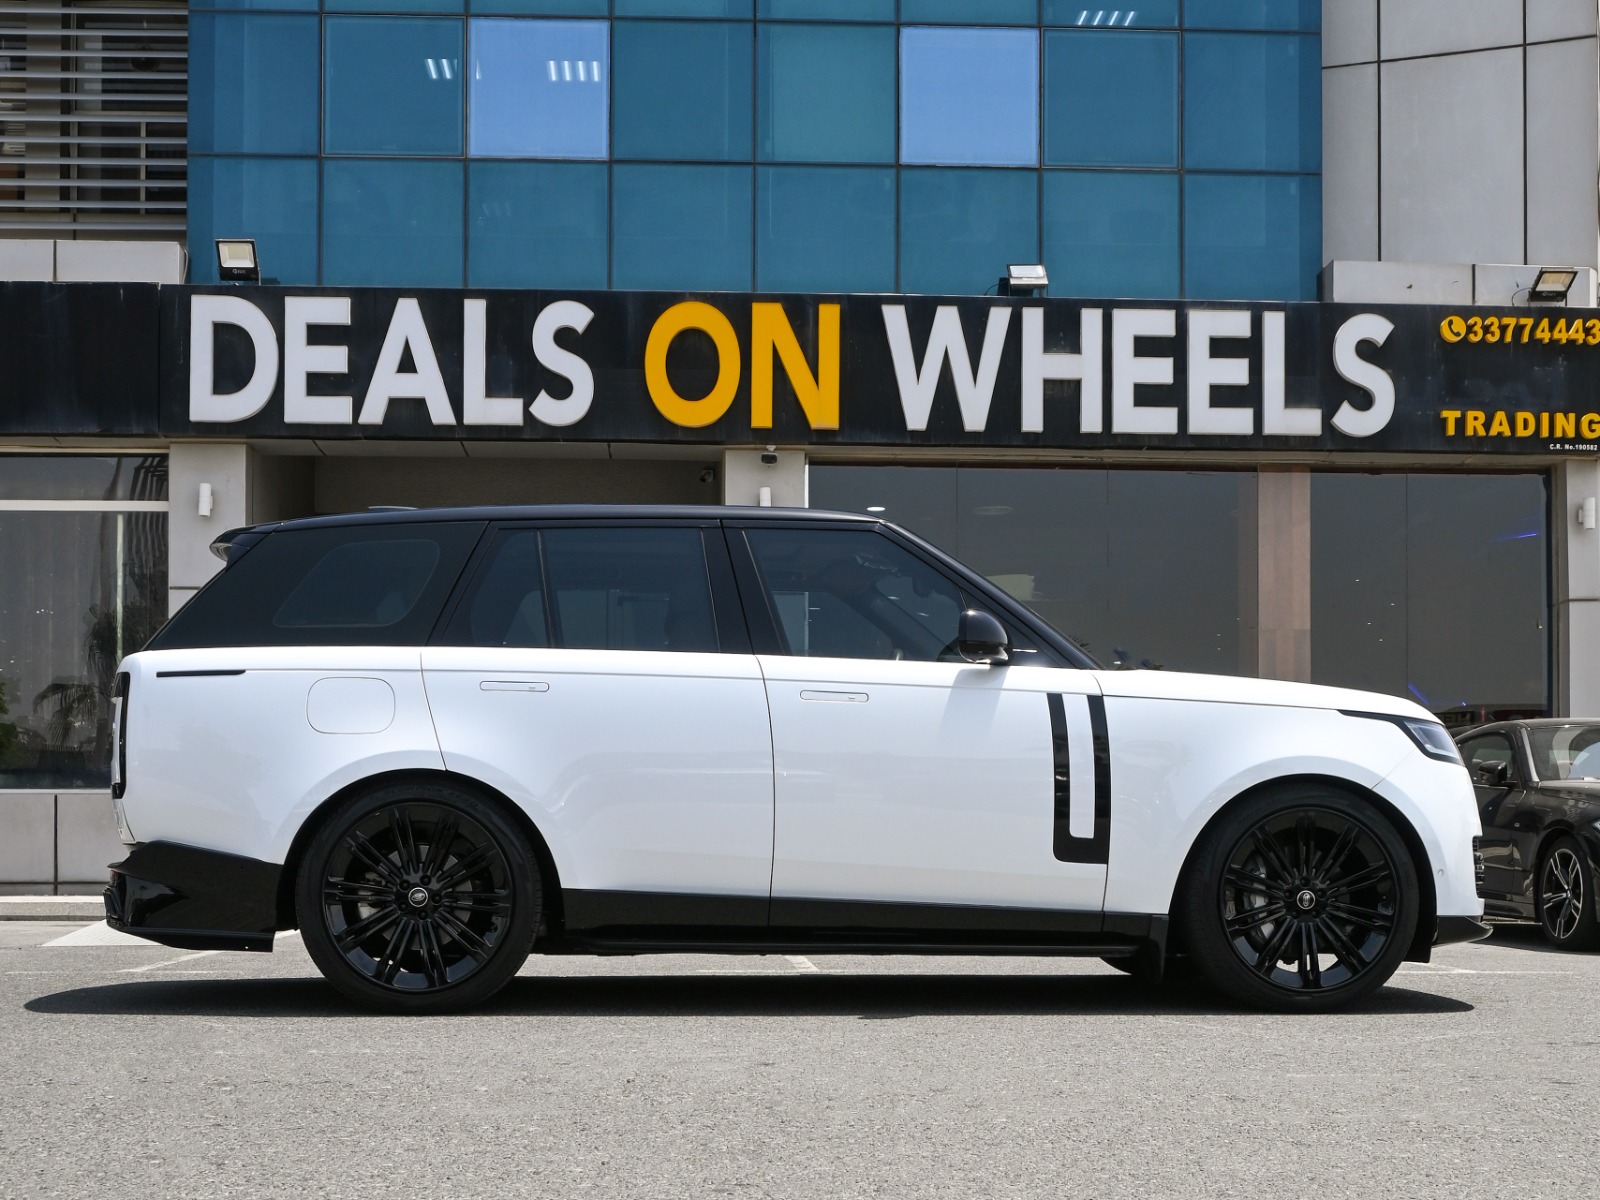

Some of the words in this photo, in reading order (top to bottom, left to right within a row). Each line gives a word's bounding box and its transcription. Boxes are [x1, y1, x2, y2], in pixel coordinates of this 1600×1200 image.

[1467, 316, 1600, 345] 33774443
[189, 294, 595, 427] DEALS
[644, 301, 841, 431] ON
[881, 304, 1396, 438] WHEELS
[1440, 410, 1600, 439] TRADING
